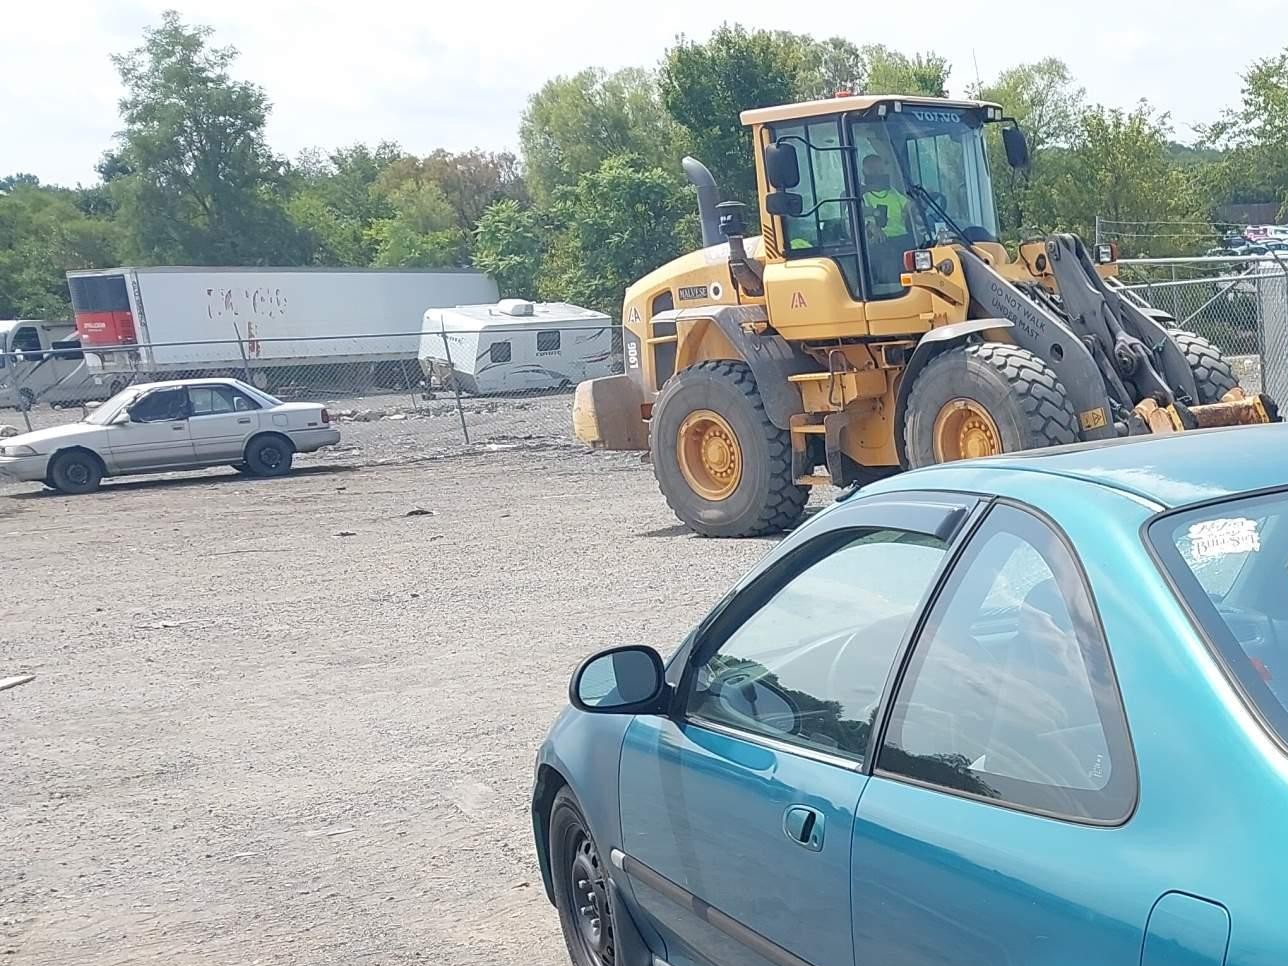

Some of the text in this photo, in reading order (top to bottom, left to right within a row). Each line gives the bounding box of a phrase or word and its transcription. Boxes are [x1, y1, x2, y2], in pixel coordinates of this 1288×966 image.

[912, 110, 960, 123] VOLVO
[991, 283, 1046, 332] DO NOT WALK
[992, 297, 1039, 340] UNDER MAST
[628, 342, 639, 369] L90G
